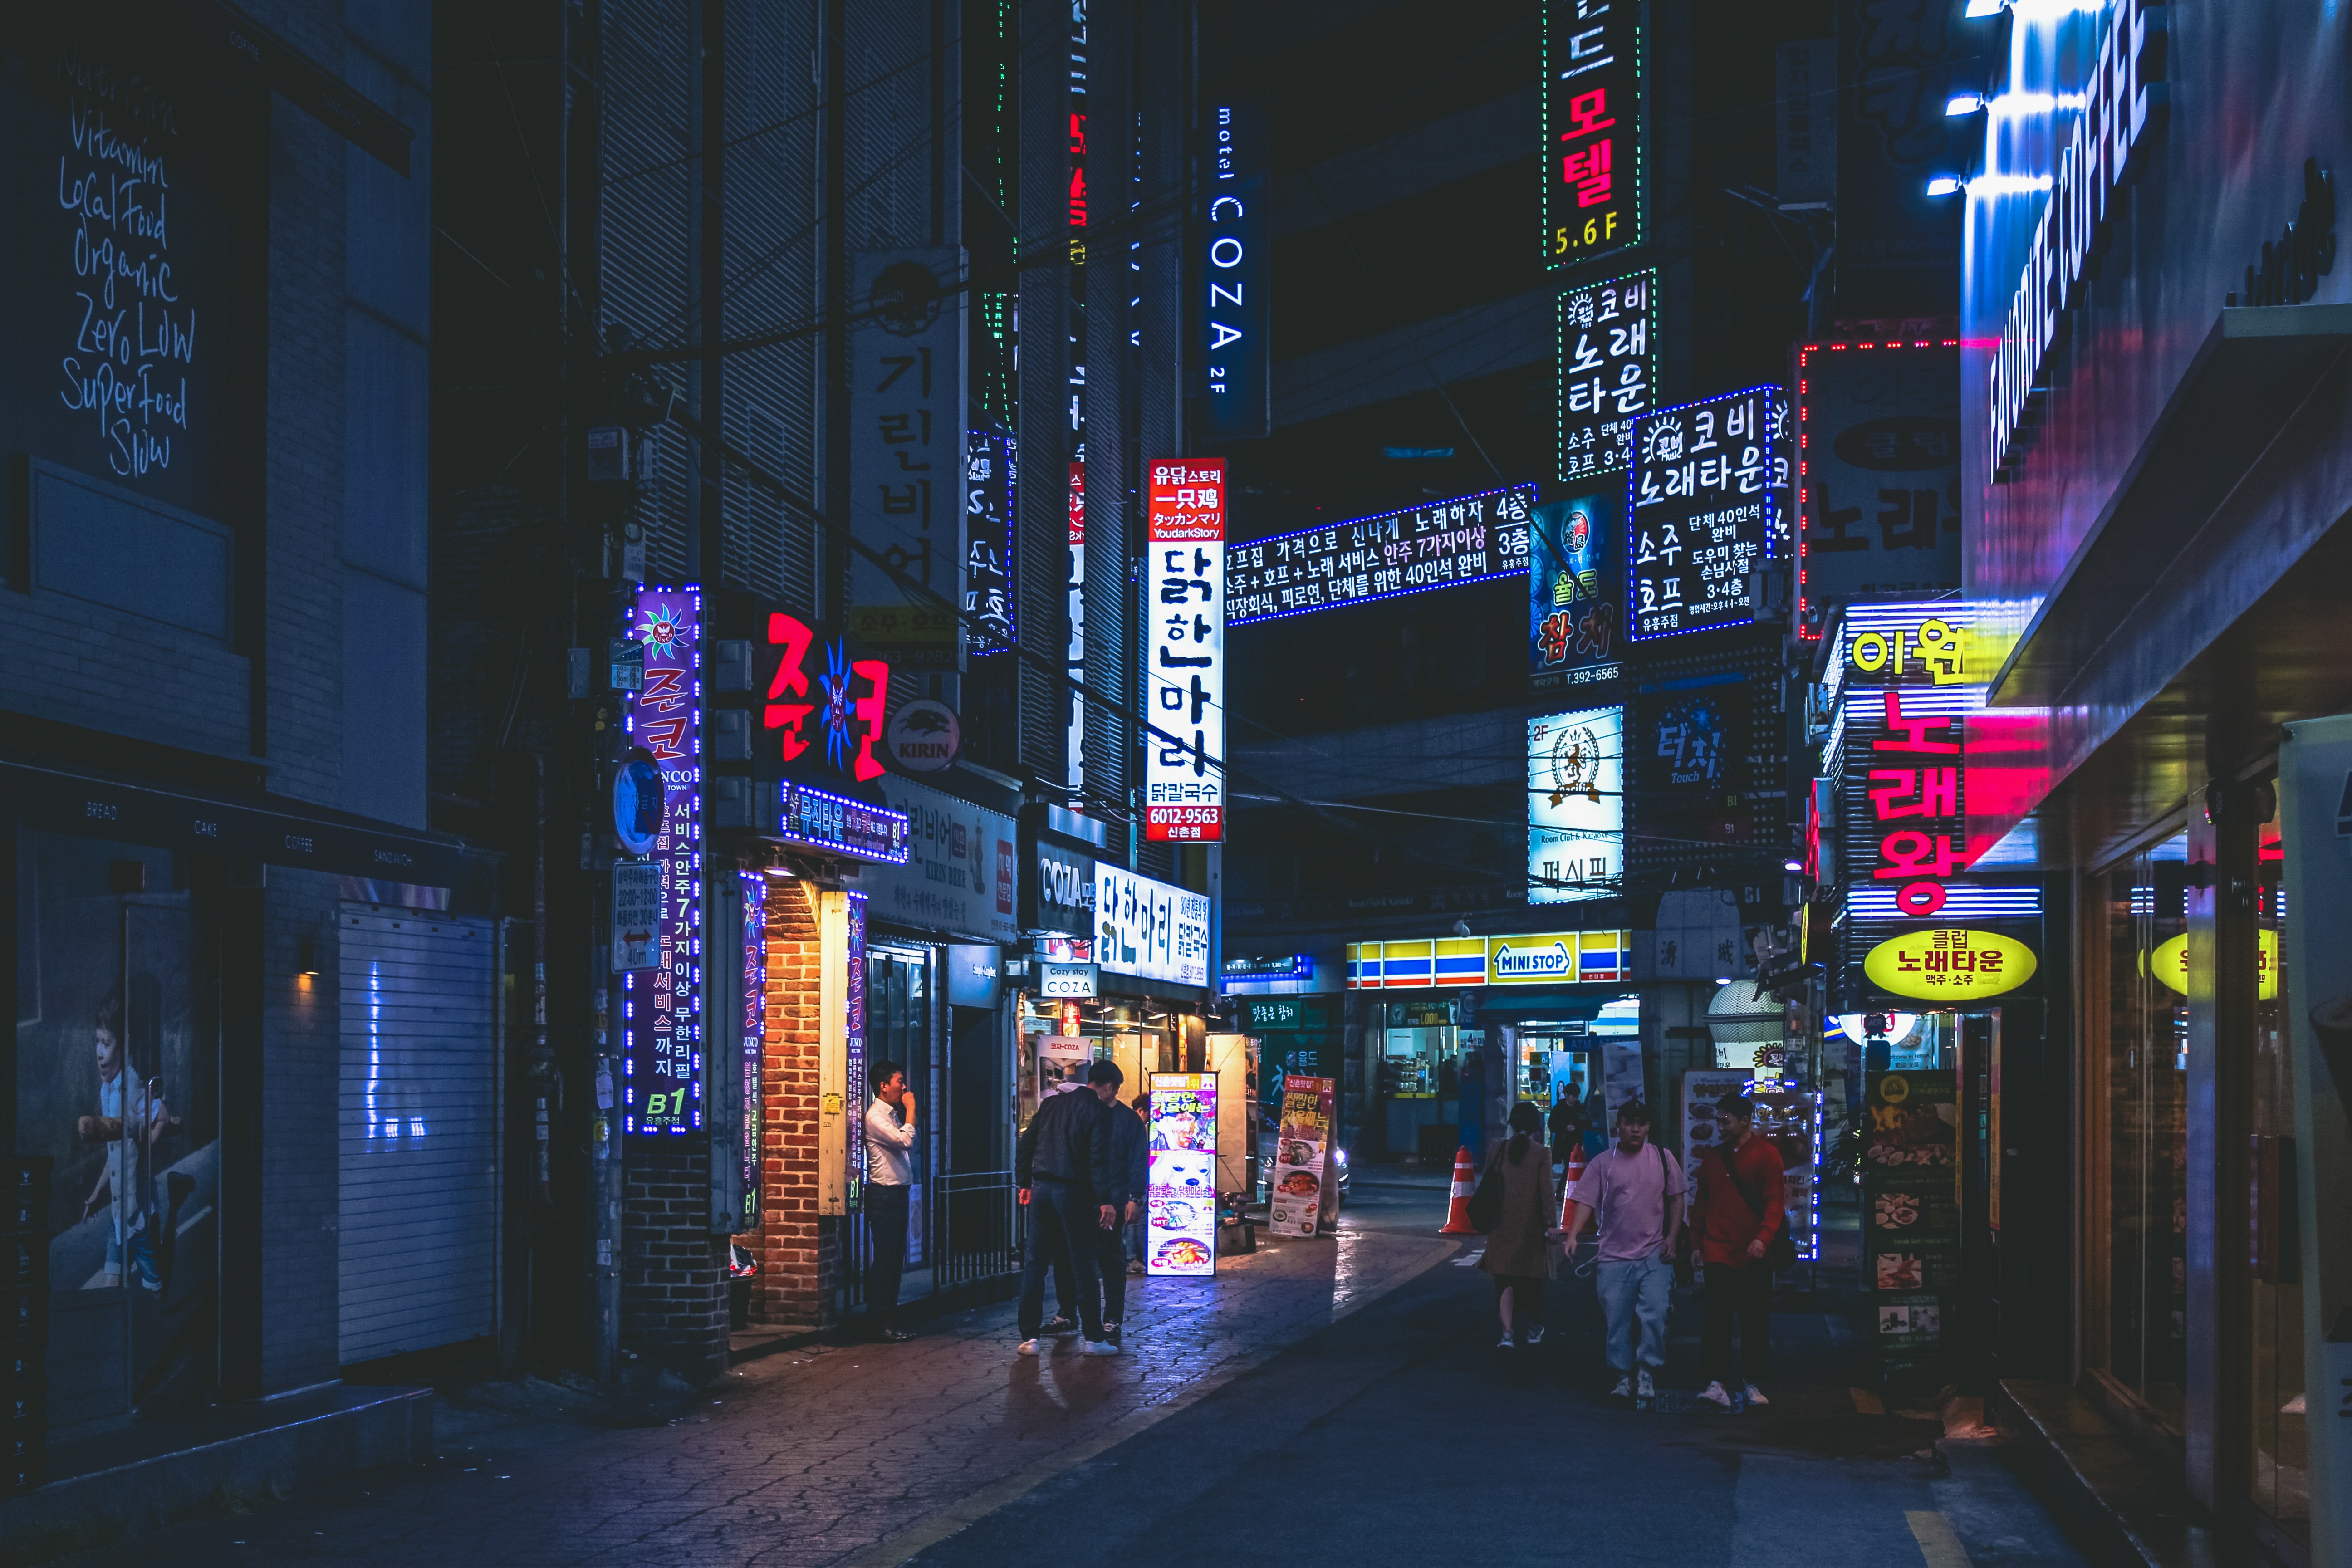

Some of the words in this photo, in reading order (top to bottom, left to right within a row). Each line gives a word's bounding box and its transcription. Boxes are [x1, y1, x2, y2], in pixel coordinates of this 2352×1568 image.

[1218, 108, 1235, 179] motel
[1561, 88, 1615, 208] 모텔
[2058, 0, 2147, 310] COFFEE
[74, 212, 178, 309] Organic
[1210, 195, 1244, 351] COZA
[1597, 280, 1646, 323] 코비
[1568, 317, 1646, 374] 노래
[1989, 185, 2055, 485] FAVORITE
[1210, 367, 1226, 394] 2F
[1568, 363, 1647, 414] 타운
[1568, 426, 1596, 450] 소주
[1601, 421, 1618, 437] 단체
[1690, 398, 1754, 454] 코비
[1568, 453, 1596, 475] 호프
[1635, 446, 1764, 508] 노래타운
[1155, 489, 1219, 509] 一只鸡
[1153, 513, 1221, 526] タッカンマリ
[1689, 512, 1715, 532] 단체
[1717, 504, 1760, 524] 40인석
[1153, 528, 1220, 540] YoudarkStory
[1276, 530, 1338, 562] 가격으로
[1351, 516, 1400, 547] 신나게
[1415, 500, 1484, 533] 노래하자
[1498, 527, 1529, 556] 3층
[1711, 523, 1737, 543] 완비
[1636, 524, 1682, 567] 소주
[1692, 544, 1729, 566] 도우미
[1732, 540, 1758, 558] 찾는
[1263, 564, 1289, 587] 호프
[1307, 557, 1333, 580] 노래
[1338, 547, 1380, 572] 서비스
[1383, 541, 1413, 565] 안주
[1502, 556, 1529, 571] 유흥주점
[1281, 585, 1324, 610] 피로연,
[1328, 576, 1369, 602] 단체를
[1373, 568, 1402, 590] 위한
[1406, 560, 1453, 586] 40인석
[1457, 551, 1487, 577] 완비
[1706, 578, 1743, 599] 3·4층
[1637, 577, 1683, 615] 호프
[1642, 612, 1678, 632] 유흥주점
[1159, 547, 1214, 779] 닭한마리
[1566, 667, 1619, 685] T.392-6565
[640, 668, 688, 762] 준코
[1533, 725, 1549, 742] 2F
[899, 743, 949, 759] KIRIN
[661, 771, 693, 783] NCO
[1671, 771, 1699, 784] Touch
[1151, 783, 1218, 804] 닭칼국수
[1868, 692, 1969, 916] 노래왕
[87, 801, 118, 821] BREAD
[801, 795, 843, 842] 뮤직타운
[1150, 807, 1219, 825] 6012-9563
[195, 820, 218, 838] CAKE
[892, 820, 901, 840] B1
[1167, 826, 1201, 839] 신촌점
[1541, 834, 1559, 844] Room
[1560, 832, 1575, 843] Club
[1583, 830, 1609, 840] Karaoke
[286, 834, 314, 853] COFFEE
[374, 849, 413, 868] SANDWICH
[926, 859, 946, 883] KIRIN
[948, 866, 966, 889] BEER
[1040, 858, 1083, 909] COZA
[1101, 875, 1171, 965] 닭한마리
[1932, 930, 1968, 949] 클럽
[1050, 968, 1070, 976] Cozy
[1073, 968, 1089, 976] stay
[1897, 950, 2003, 972] 노래타운
[745, 945, 758, 1029] 준코
[851, 956, 862, 1032] 준코
[1047, 981, 1091, 993] COZA
[1253, 1006, 1275, 1022] 맛좋은
[1278, 1005, 1293, 1021] 참치
[675, 1007, 691, 1079] 무한리필
[744, 1036, 759, 1048] JUNCO
[849, 1037, 862, 1047] JUNCO
[1298, 1051, 1318, 1066] 율도
[647, 1088, 686, 1115] B1
[645, 1116, 680, 1126] 유흥주점
[850, 1174, 859, 1199] B1
[745, 1187, 756, 1214] B1
